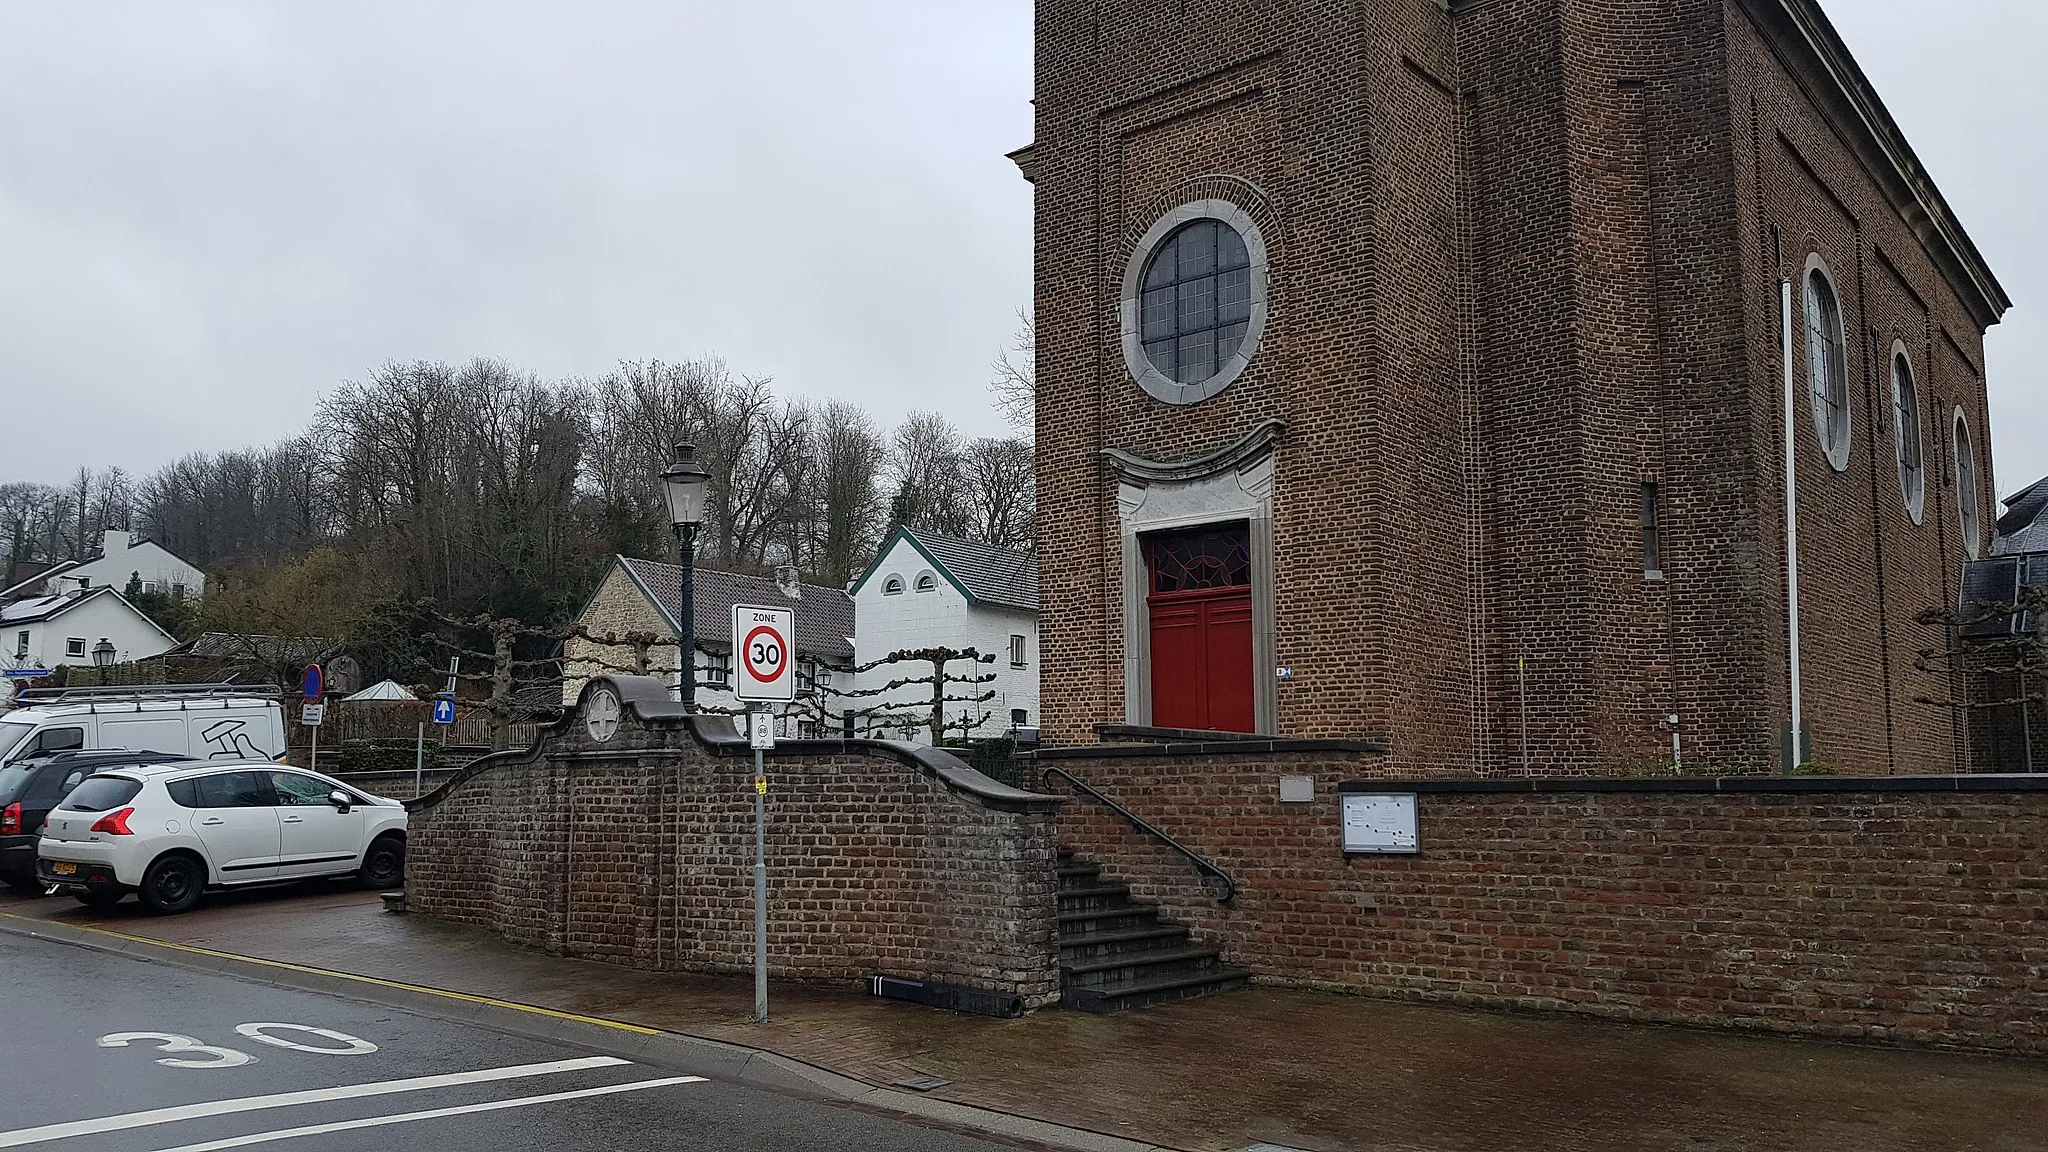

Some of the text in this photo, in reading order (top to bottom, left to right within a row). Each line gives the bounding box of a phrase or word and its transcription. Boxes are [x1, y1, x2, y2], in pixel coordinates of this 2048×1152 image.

[753, 613, 776, 623] ZONE
[752, 643, 780, 665] 30
[98, 1022, 379, 1069] 30
